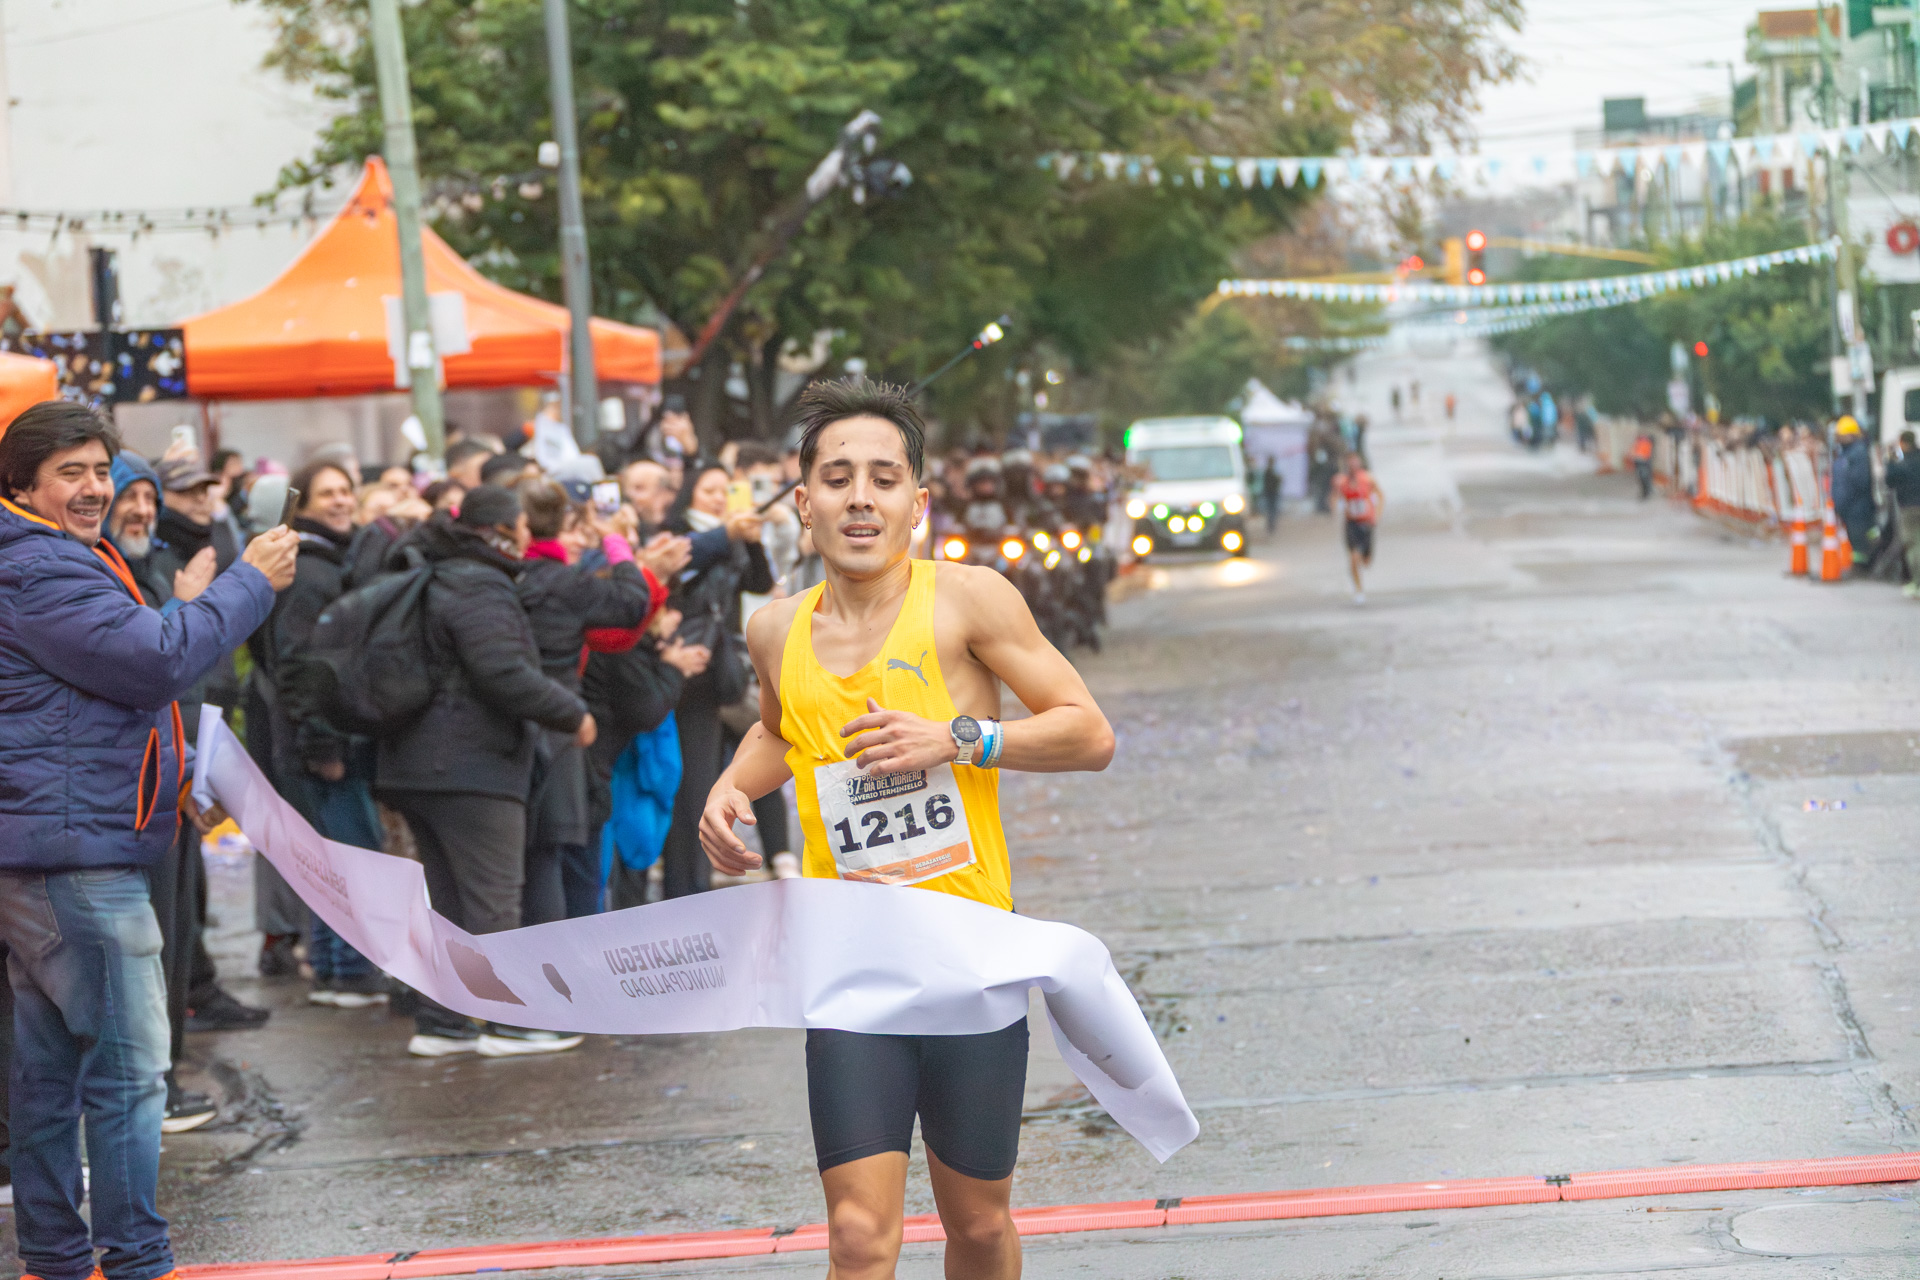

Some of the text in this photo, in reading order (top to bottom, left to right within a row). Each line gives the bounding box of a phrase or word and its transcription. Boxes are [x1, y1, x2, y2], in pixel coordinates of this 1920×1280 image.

[876, 778, 890, 790] DEL
[890, 770, 922, 787] VIDRIERO
[850, 781, 923, 803] SAVERIO TERMINIELLO
[833, 793, 956, 854] 1216
